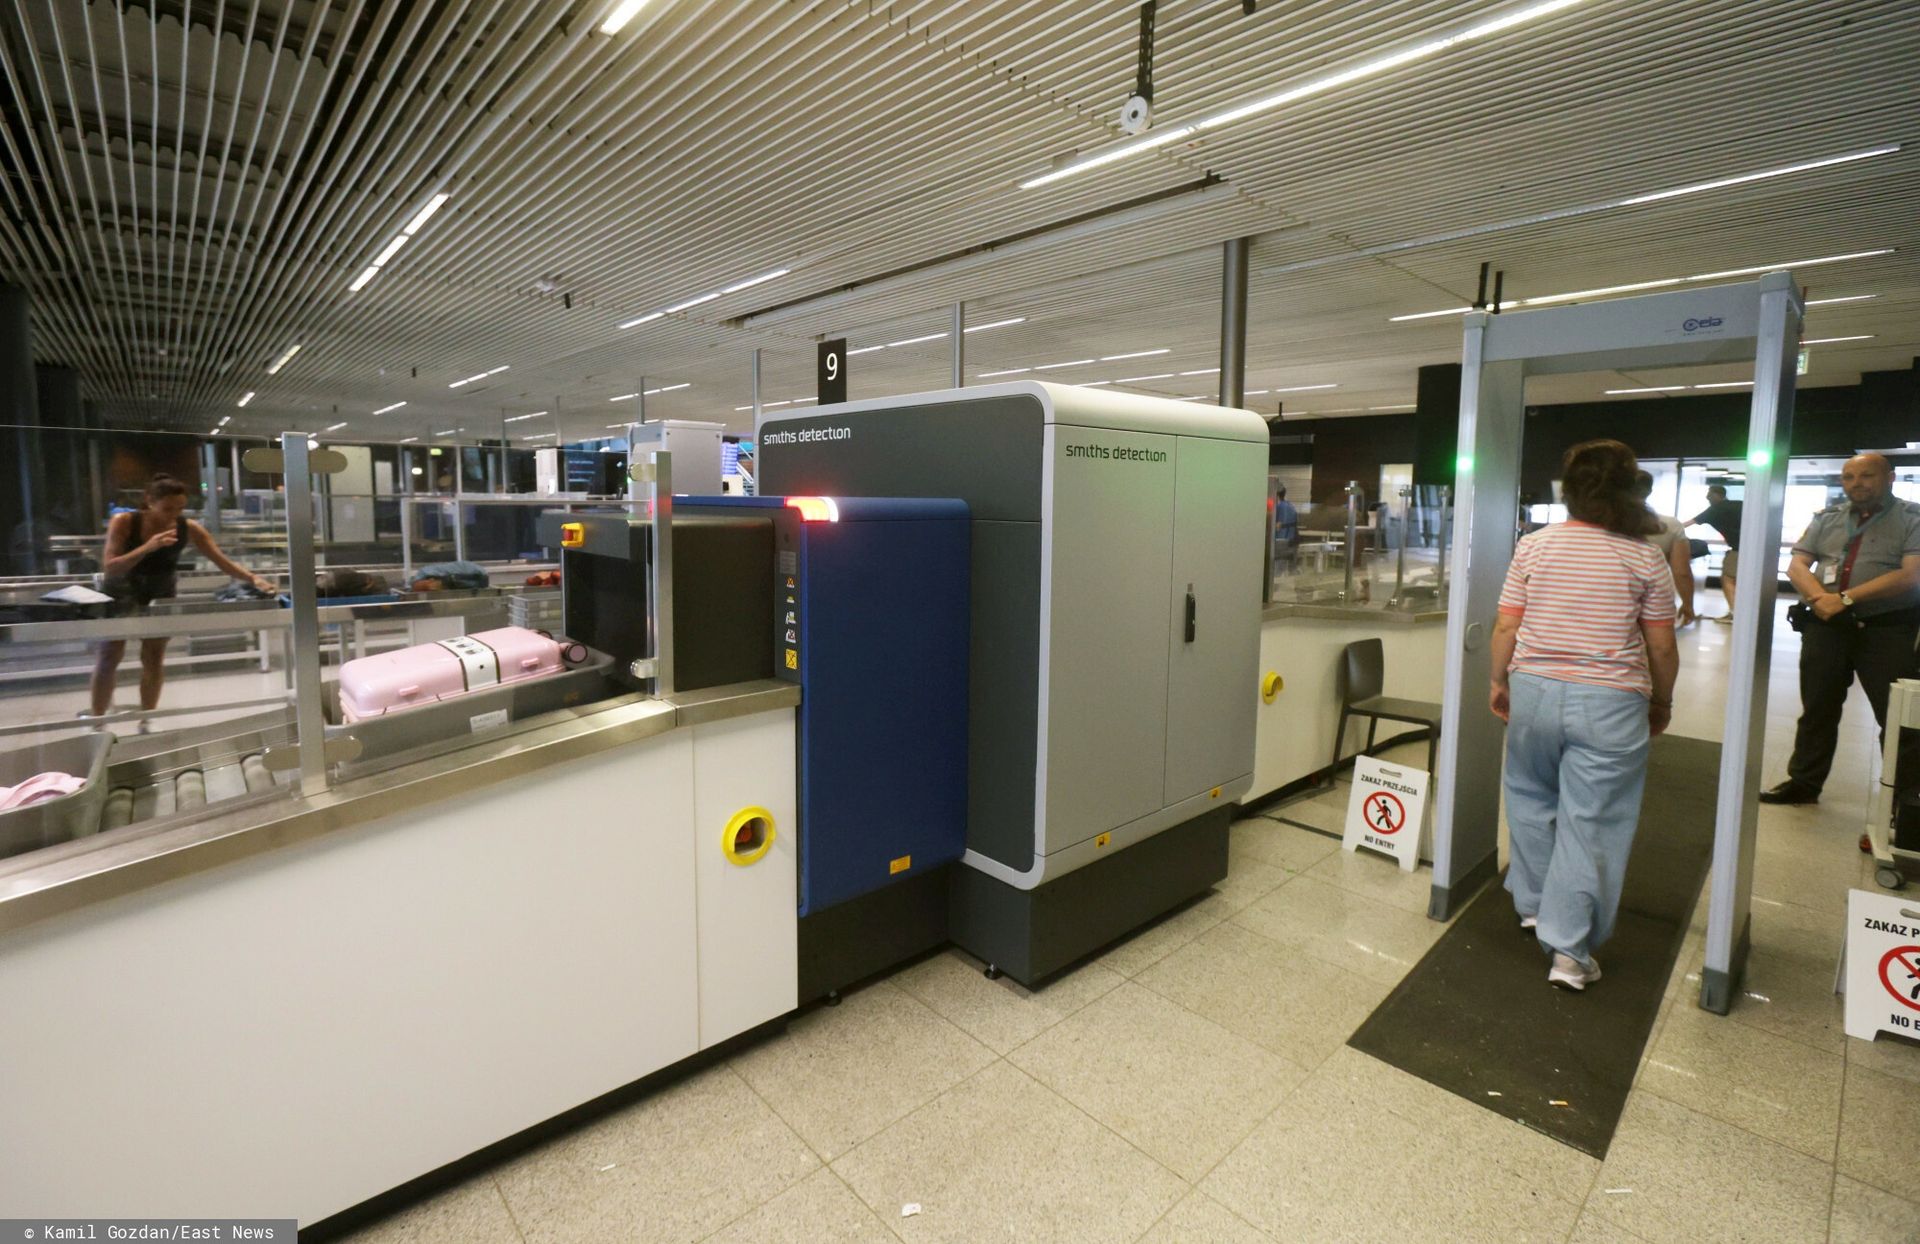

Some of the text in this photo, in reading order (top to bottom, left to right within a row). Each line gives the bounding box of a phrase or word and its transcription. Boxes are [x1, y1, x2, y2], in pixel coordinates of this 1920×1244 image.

[826, 352, 838, 381] 9
[763, 426, 851, 446] smiths detection
[1065, 444, 1167, 462] smiths detection
[1361, 774, 1381, 786] ZAKAZ
[1364, 834, 1395, 850] NO ENTRY
[1864, 917, 1908, 937] ZAKAZ
[1890, 1013, 1910, 1028] NO
